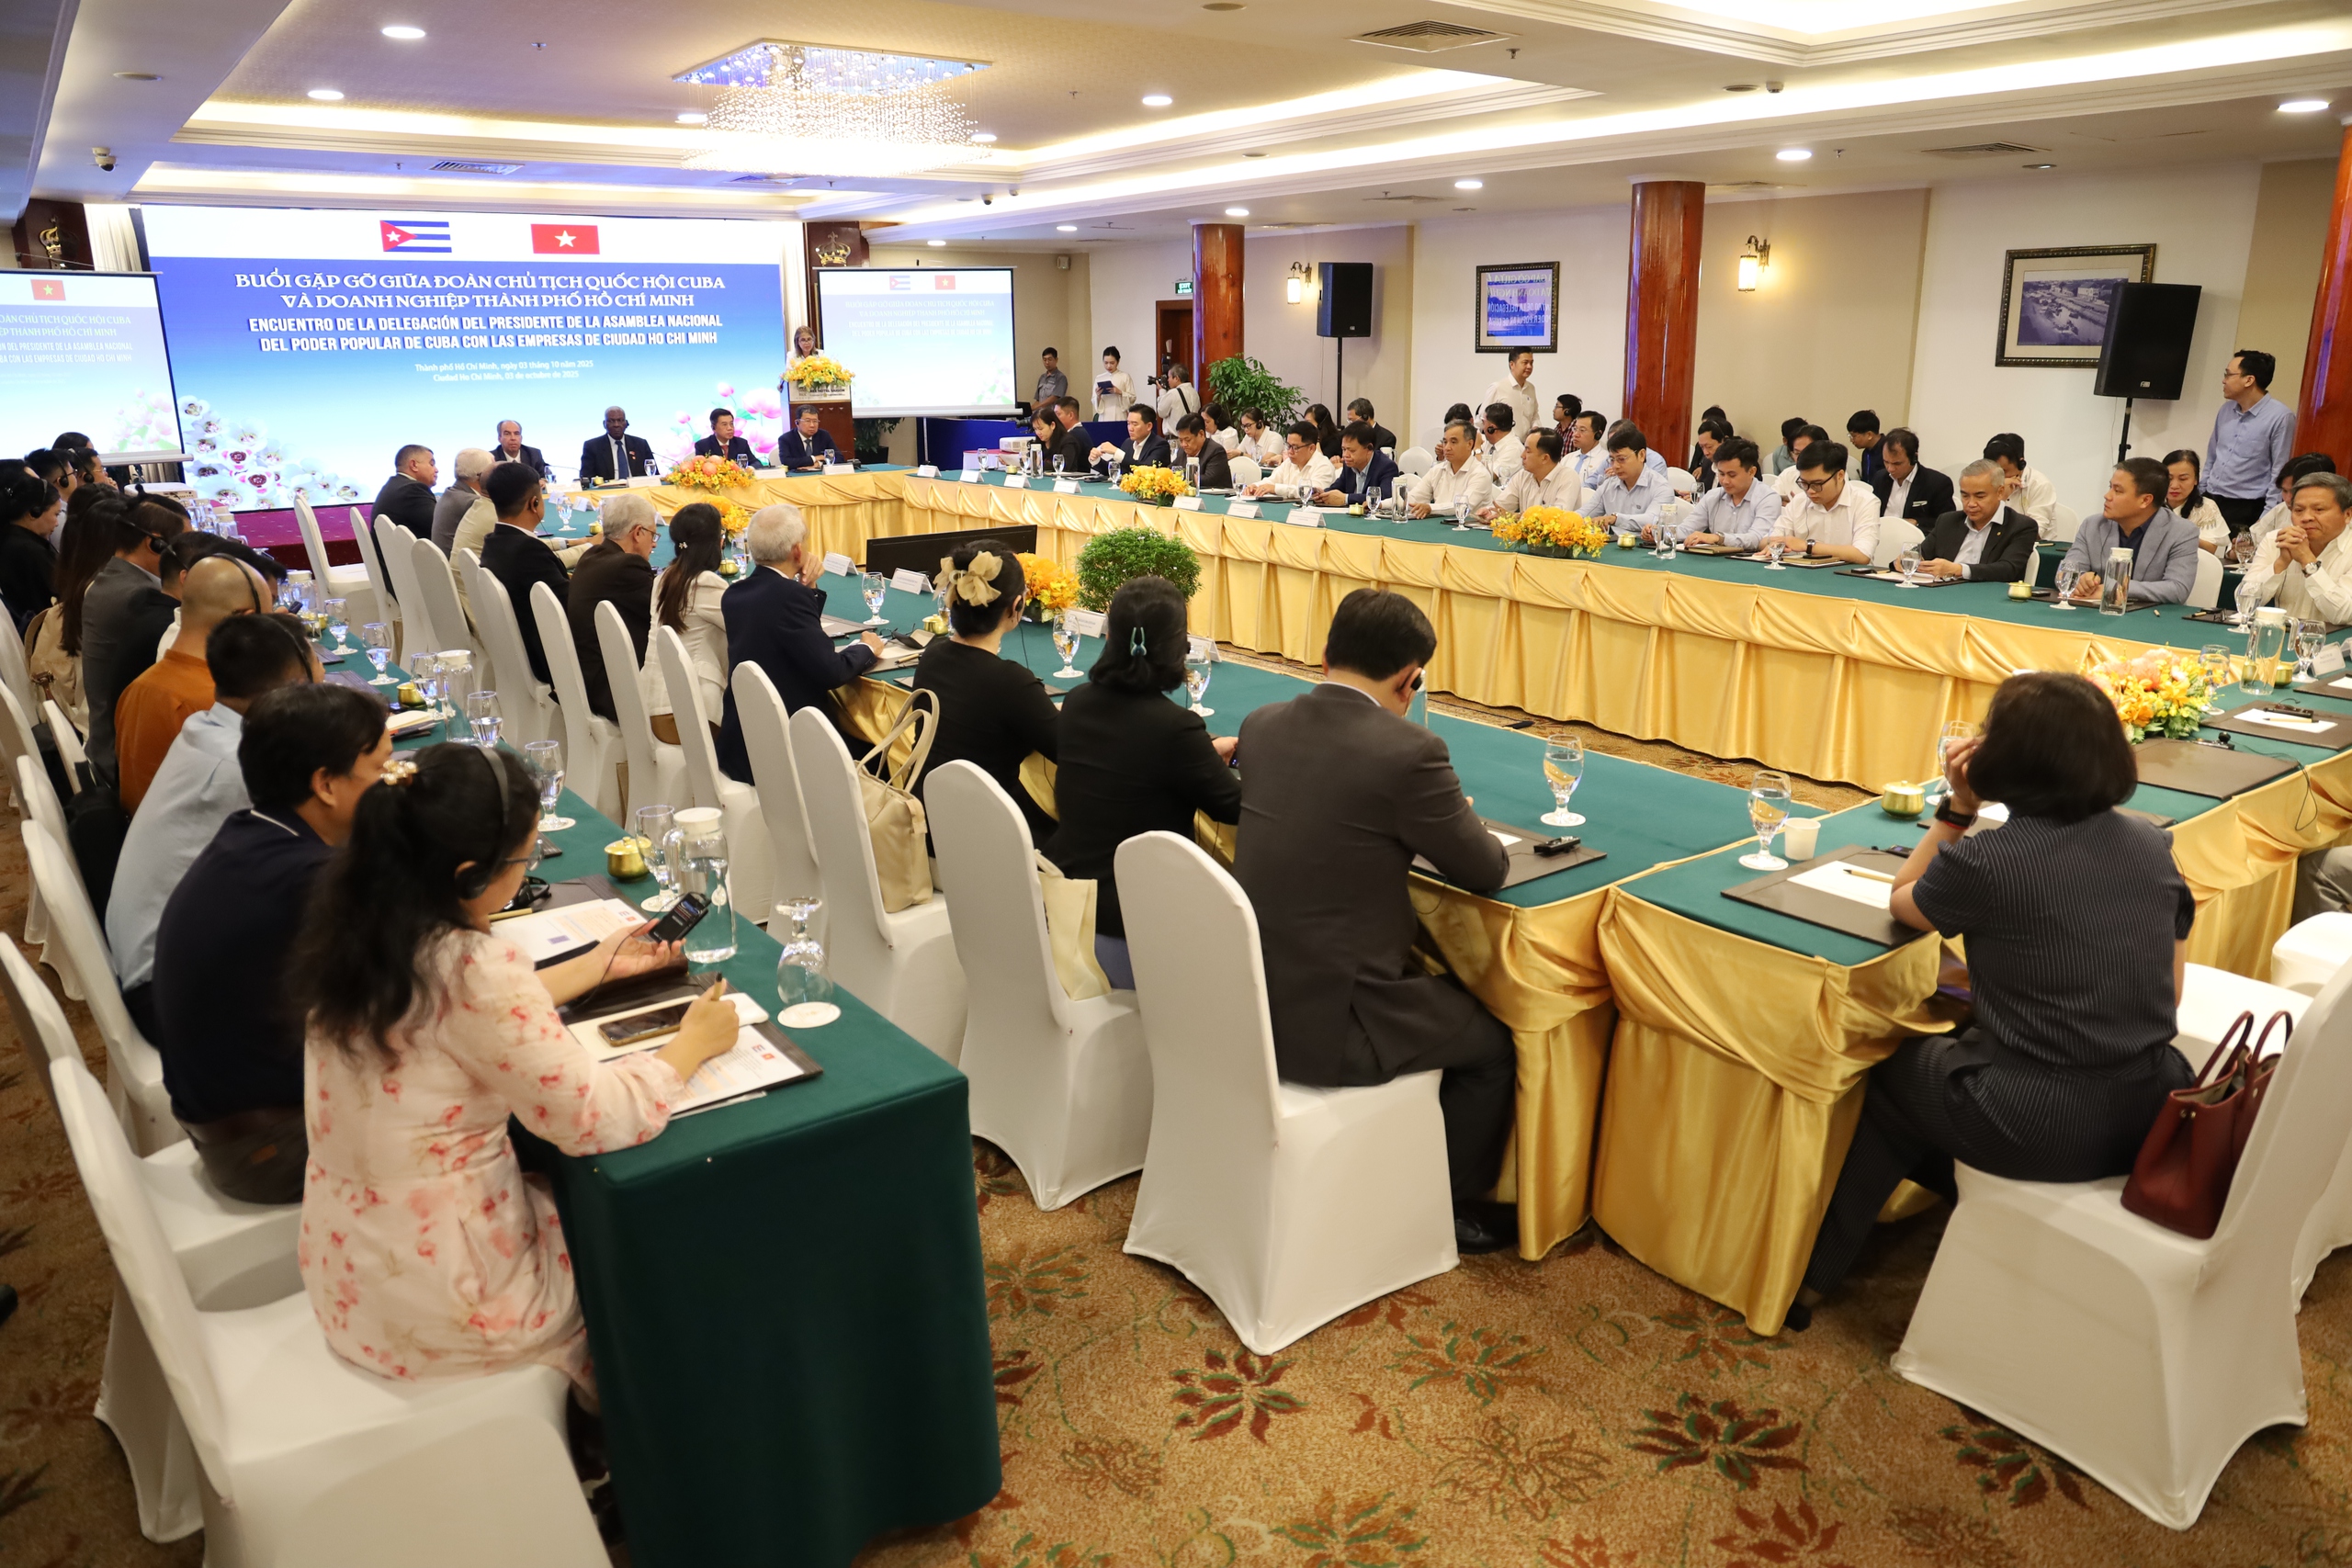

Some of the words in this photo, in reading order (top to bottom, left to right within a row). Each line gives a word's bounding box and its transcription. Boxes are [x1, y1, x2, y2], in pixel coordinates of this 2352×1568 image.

[235, 267, 291, 288] BUỔI
[295, 273, 340, 290] GẶP
[343, 273, 377, 288] GỠ
[379, 273, 432, 288] GIỮA
[434, 273, 492, 288] ĐOÀN
[494, 271, 537, 288] CHỦ
[538, 276, 583, 291] TỊCH
[584, 272, 640, 291] QUỐC
[642, 274, 675, 291] HỘI
[677, 276, 725, 289] CUBA
[280, 292, 313, 308] VÀ
[315, 295, 394, 308] DOANH
[395, 292, 469, 310] NGHIỆP
[471, 292, 539, 308] THÀNH
[541, 291, 582, 307] PHỐ
[584, 290, 612, 307] HỒ
[615, 292, 646, 307] CHÍ
[649, 294, 695, 307] MINH
[0, 313, 17, 323] OÀN
[248, 318, 334, 332] ENCUENTRO
[336, 318, 355, 332] DE
[357, 318, 376, 331] LA
[378, 315, 459, 331] DELEGACIÓN
[462, 316, 487, 330] DEL
[489, 316, 563, 330] PRESIDENTE
[566, 315, 582, 329] DE
[584, 315, 601, 329] LA
[603, 315, 665, 328] ASAMBLEA
[667, 314, 723, 328] NACIONAL
[7, 342, 19, 351] DEL
[19, 342, 55, 351] PRESIDENTE
[55, 342, 63, 350] DE
[64, 342, 72, 350] LA
[73, 342, 104, 350] ASAMBLEA
[105, 342, 133, 350] NACIONAL
[259, 338, 288, 352] DEL
[291, 337, 337, 351] PODER
[340, 336, 401, 351] POPULAR
[404, 336, 421, 349] DE
[424, 335, 459, 349] CUBA
[461, 335, 488, 348] CON
[491, 334, 514, 348] LAS
[516, 333, 582, 347] EMPRESAS
[584, 333, 600, 346] DE
[603, 333, 646, 346] CIUDAD
[648, 333, 664, 344] HO
[666, 332, 685, 344] CHI
[687, 332, 718, 344] MINH
[9, 355, 21, 363] CON
[22, 355, 34, 363] LAS
[34, 355, 65, 363] EMPRESAS
[74, 354, 96, 362] CIUDAD
[96, 354, 105, 362] HO
[106, 354, 116, 362] CHI
[117, 354, 132, 362] MINH
